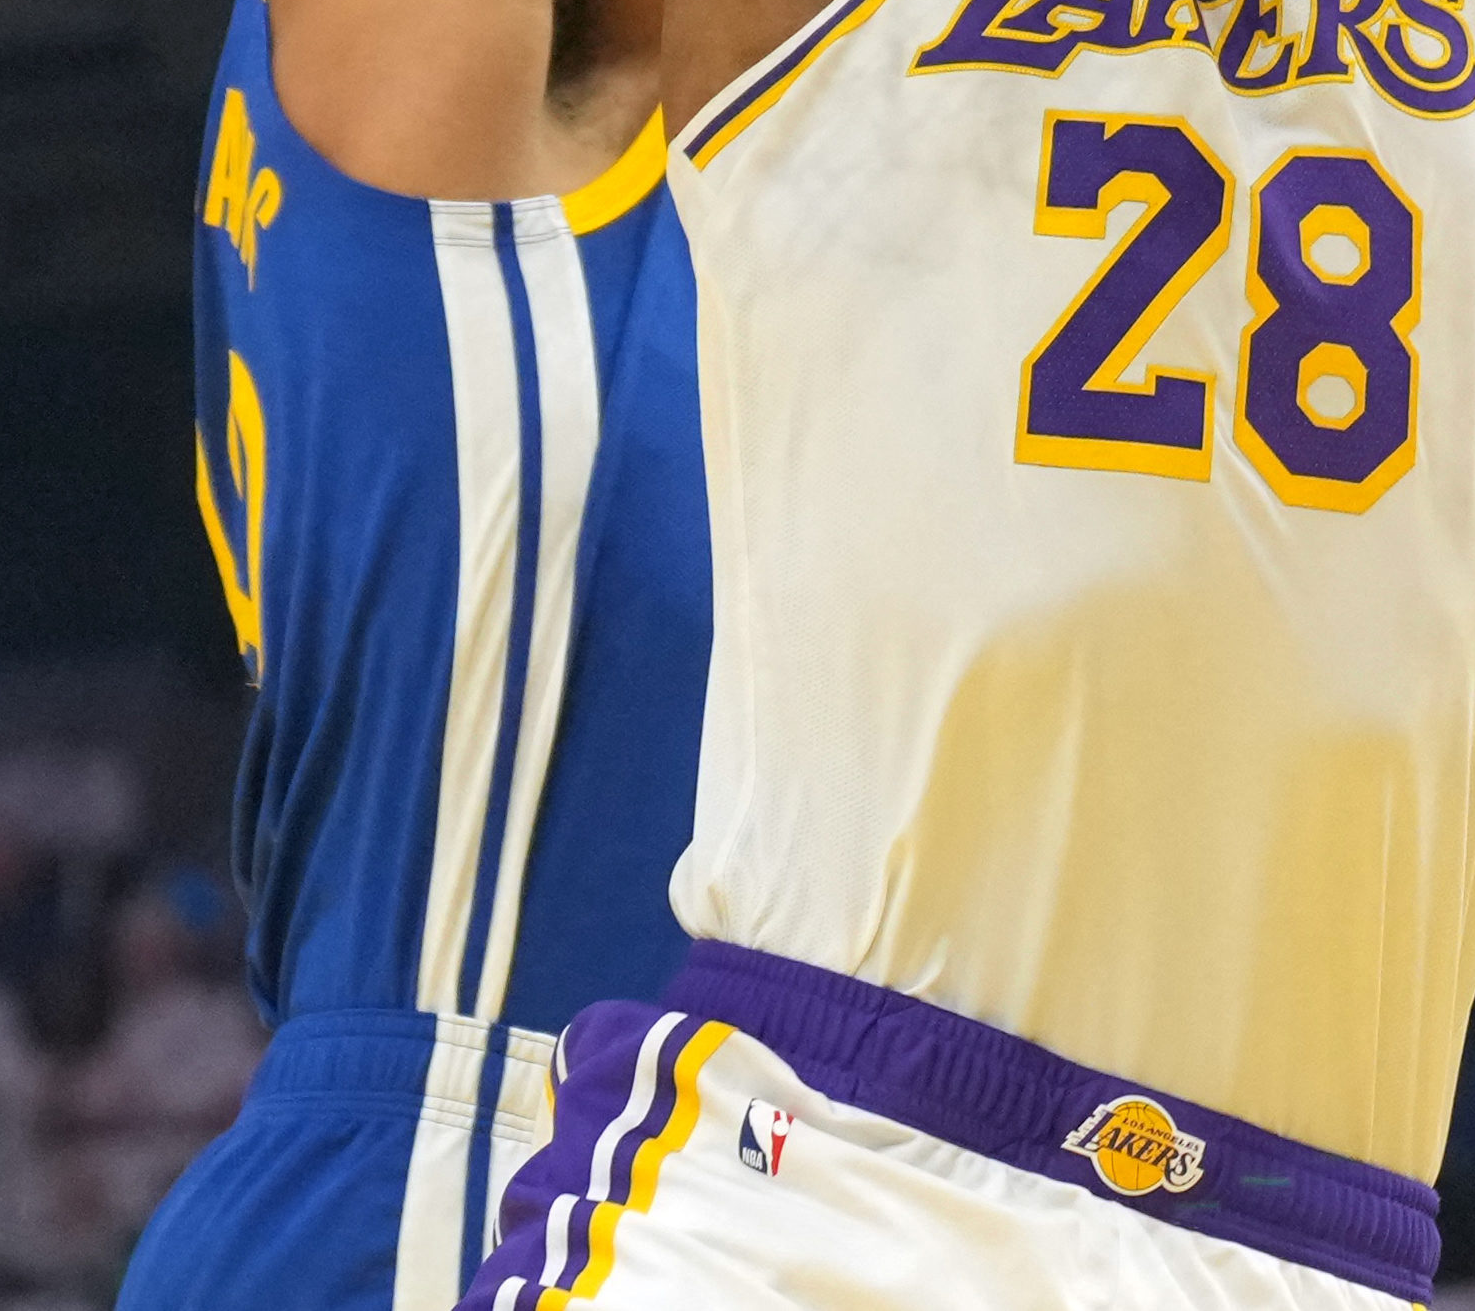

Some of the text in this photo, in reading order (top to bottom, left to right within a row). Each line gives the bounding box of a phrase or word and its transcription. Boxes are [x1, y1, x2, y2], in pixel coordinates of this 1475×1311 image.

[1014, 108, 1424, 516] 28
[742, 1146, 764, 1171] NBA
[1076, 1111, 1196, 1187] LAKERS
[1122, 1117, 1199, 1152] LOS ANGELES
